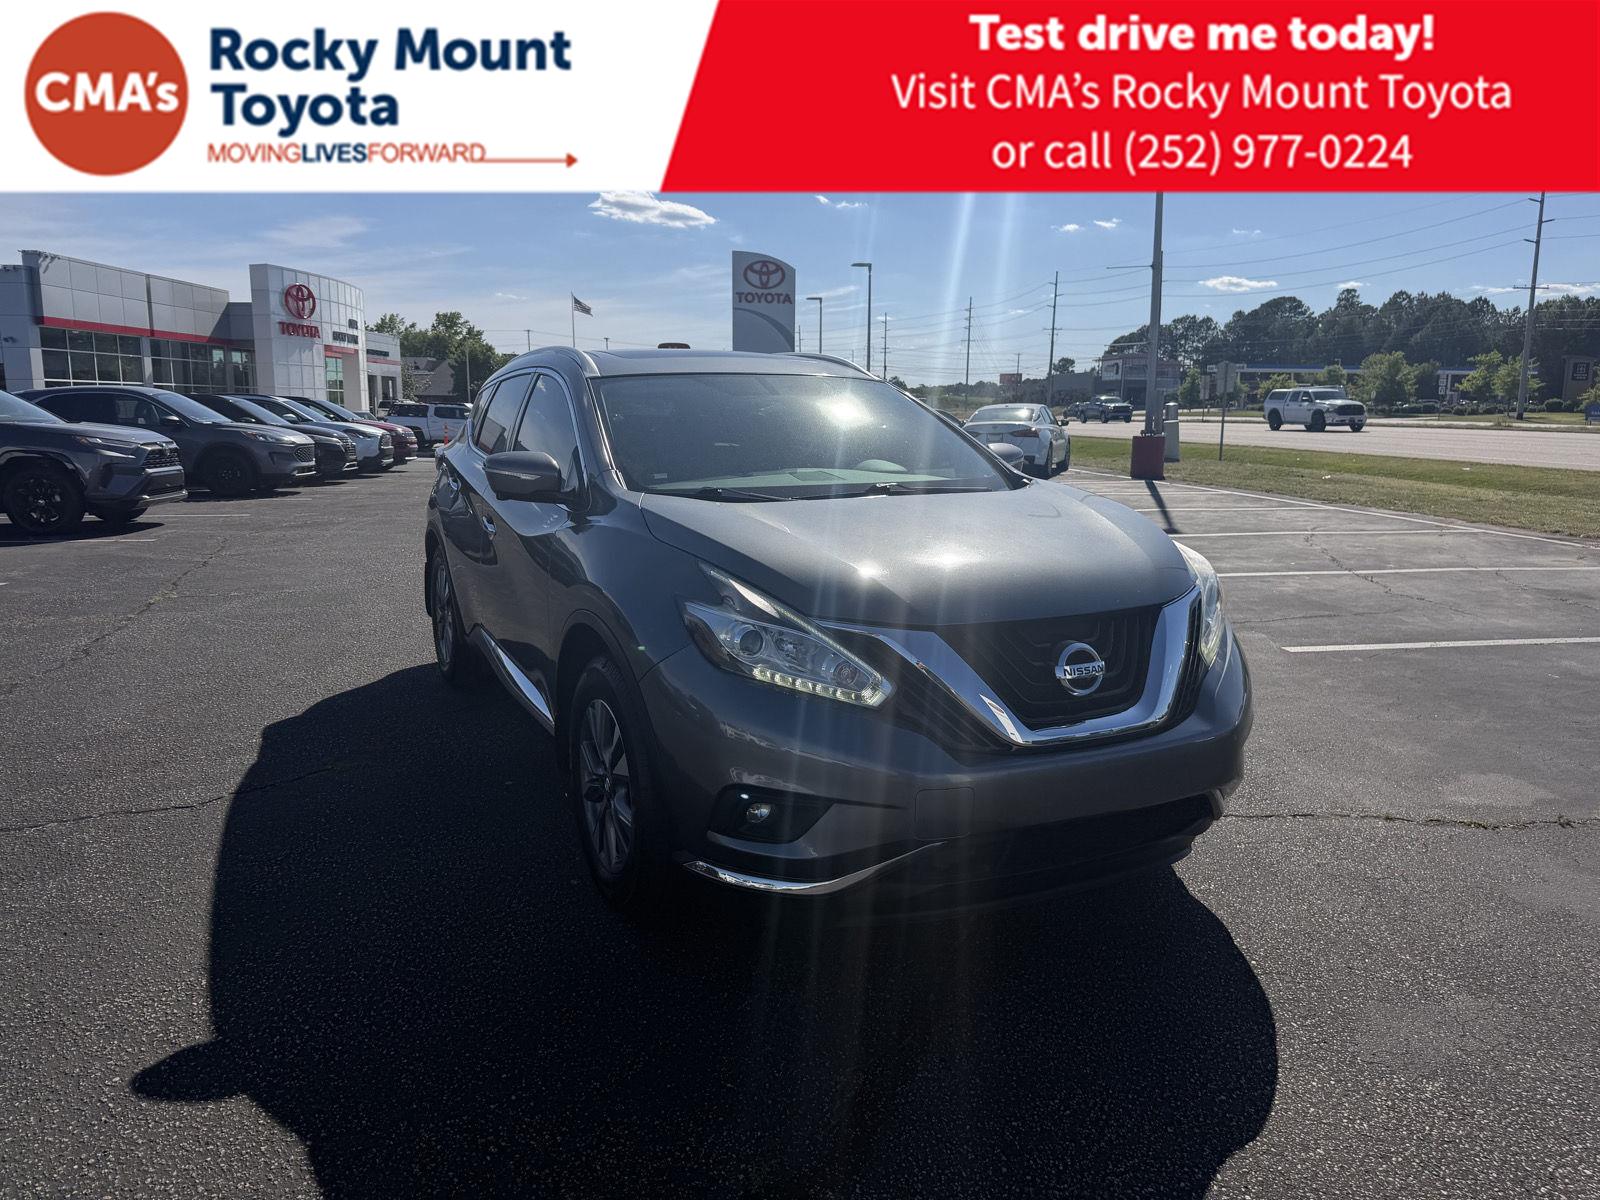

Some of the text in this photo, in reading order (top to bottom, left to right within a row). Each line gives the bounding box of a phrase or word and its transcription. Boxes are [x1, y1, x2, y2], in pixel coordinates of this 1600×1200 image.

[736, 292, 793, 305] TOYOTA
[278, 321, 321, 339] TOYOTA
[1063, 664, 1104, 677] NISSAN
